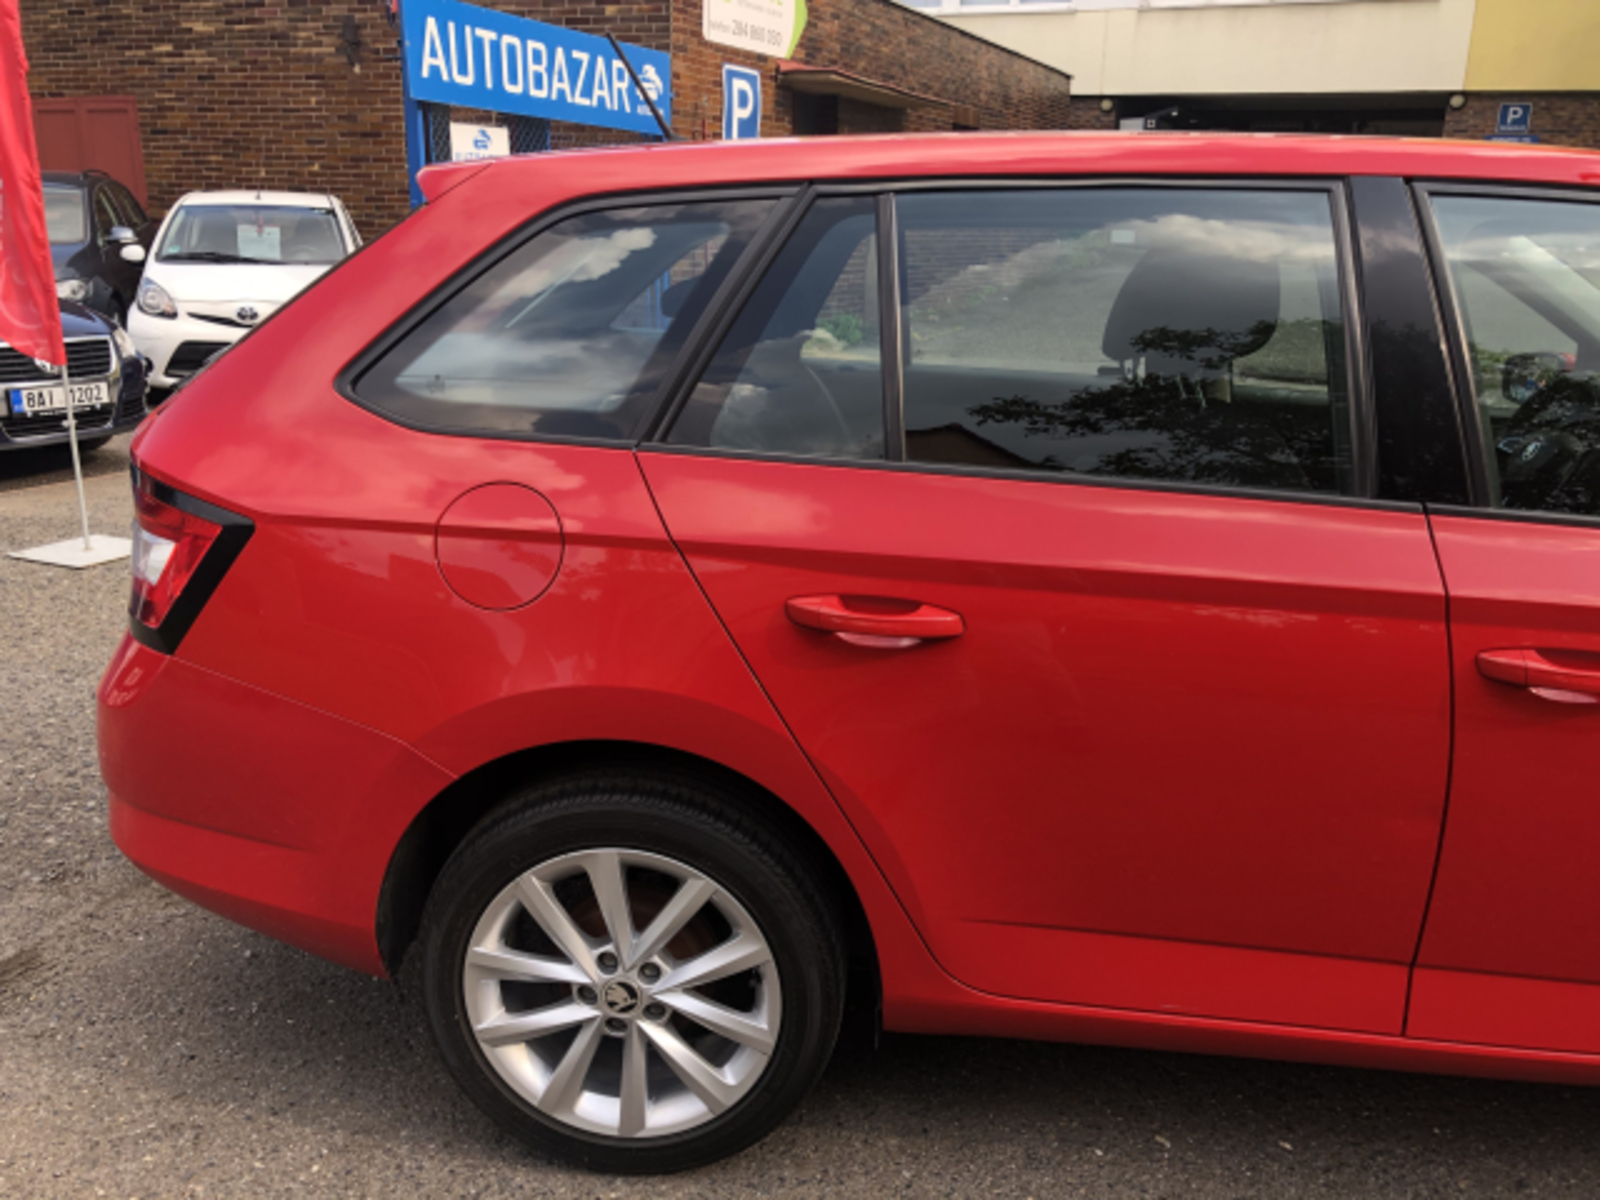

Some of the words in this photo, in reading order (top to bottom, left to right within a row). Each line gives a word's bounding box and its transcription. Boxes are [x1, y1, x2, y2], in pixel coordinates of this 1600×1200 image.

[422, 16, 631, 113] AUTOBAZAR
[732, 77, 754, 138] P
[1507, 107, 1523, 125] P
